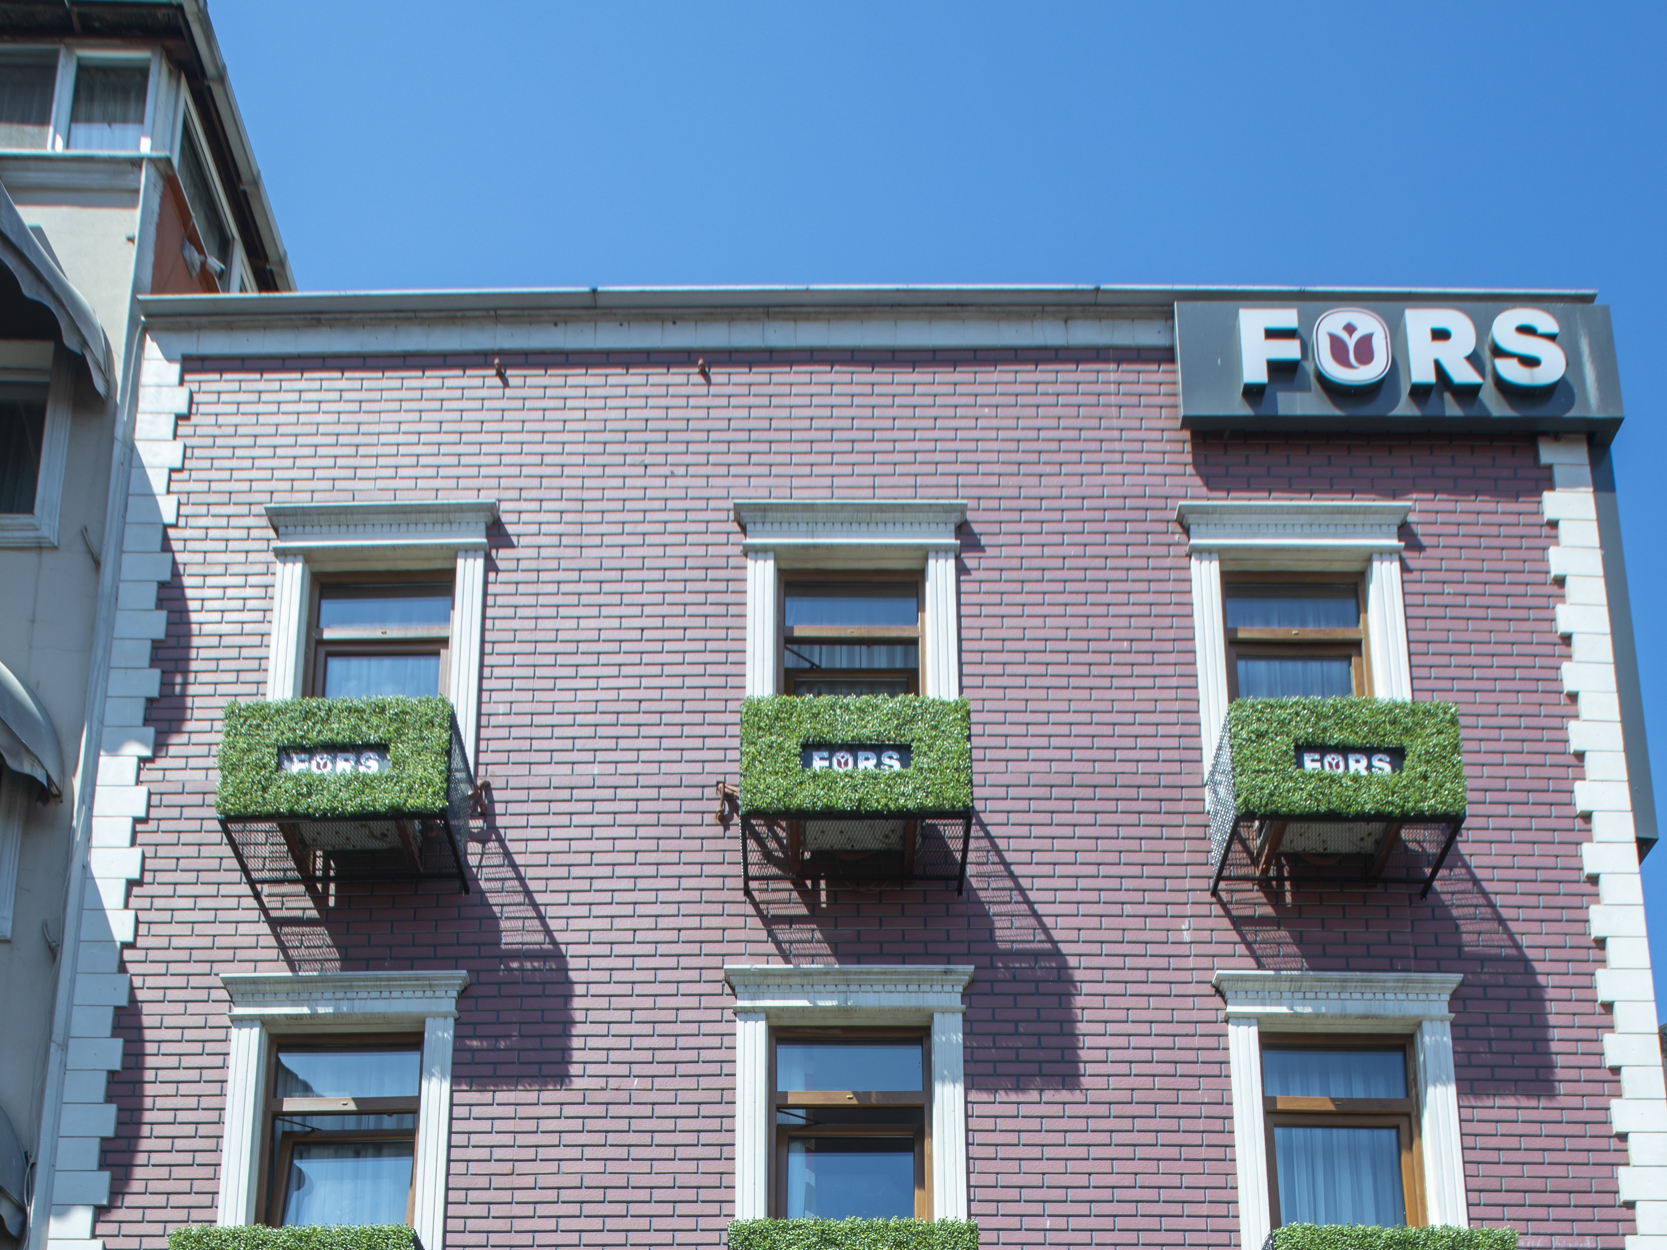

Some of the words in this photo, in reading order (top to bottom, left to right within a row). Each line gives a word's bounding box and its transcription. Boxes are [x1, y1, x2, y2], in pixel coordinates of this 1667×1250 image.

[1238, 307, 1568, 392] FORS
[812, 751, 901, 772] FORS
[1302, 753, 1392, 775] FORS
